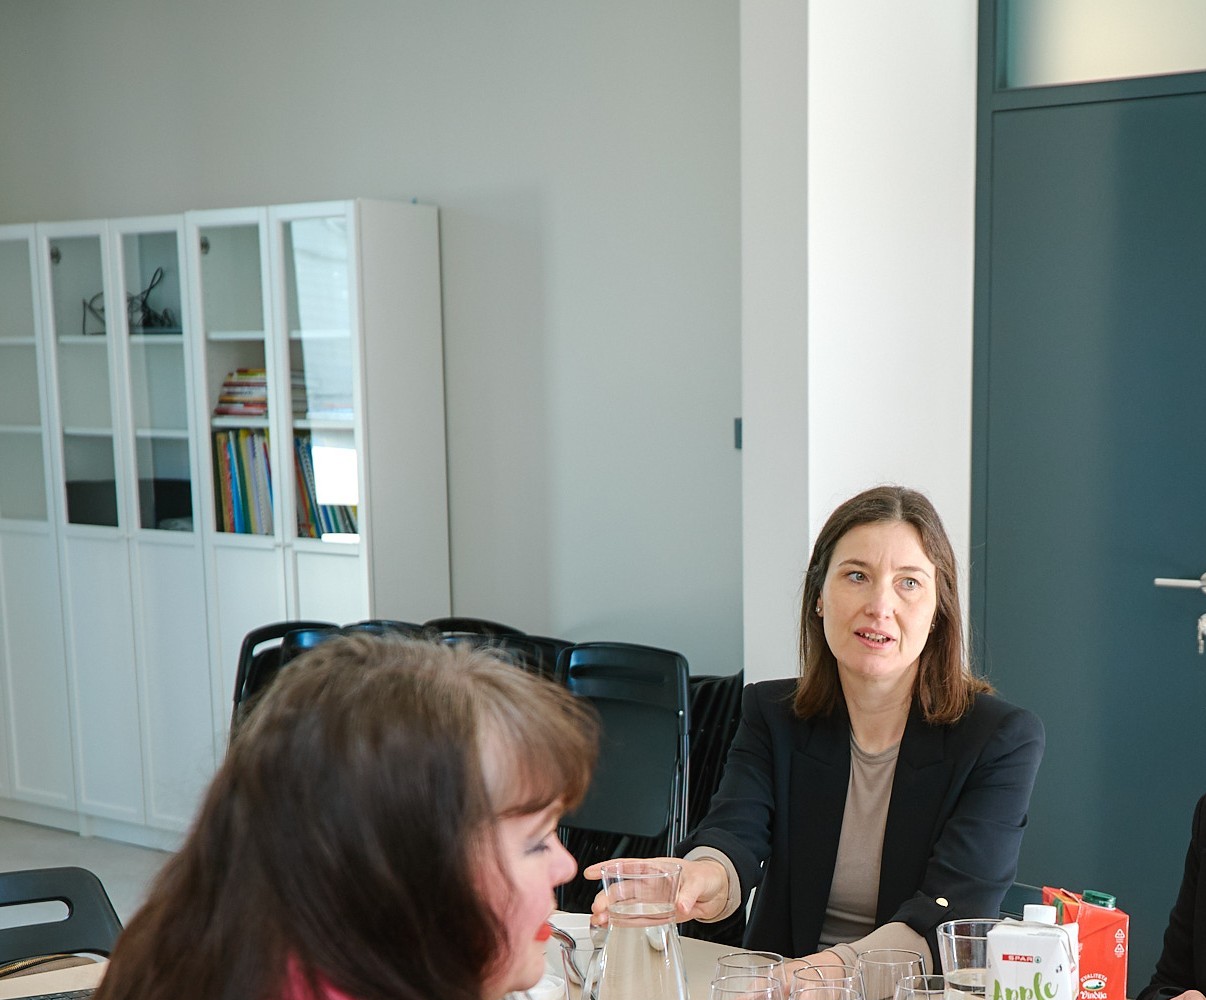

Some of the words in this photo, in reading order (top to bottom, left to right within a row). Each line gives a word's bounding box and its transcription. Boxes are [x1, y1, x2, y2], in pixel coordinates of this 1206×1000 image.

[1008, 955, 1033, 963] SPAR
[1080, 973, 1108, 983] KVALITETA
[1080, 991, 1107, 1000] Vindija
